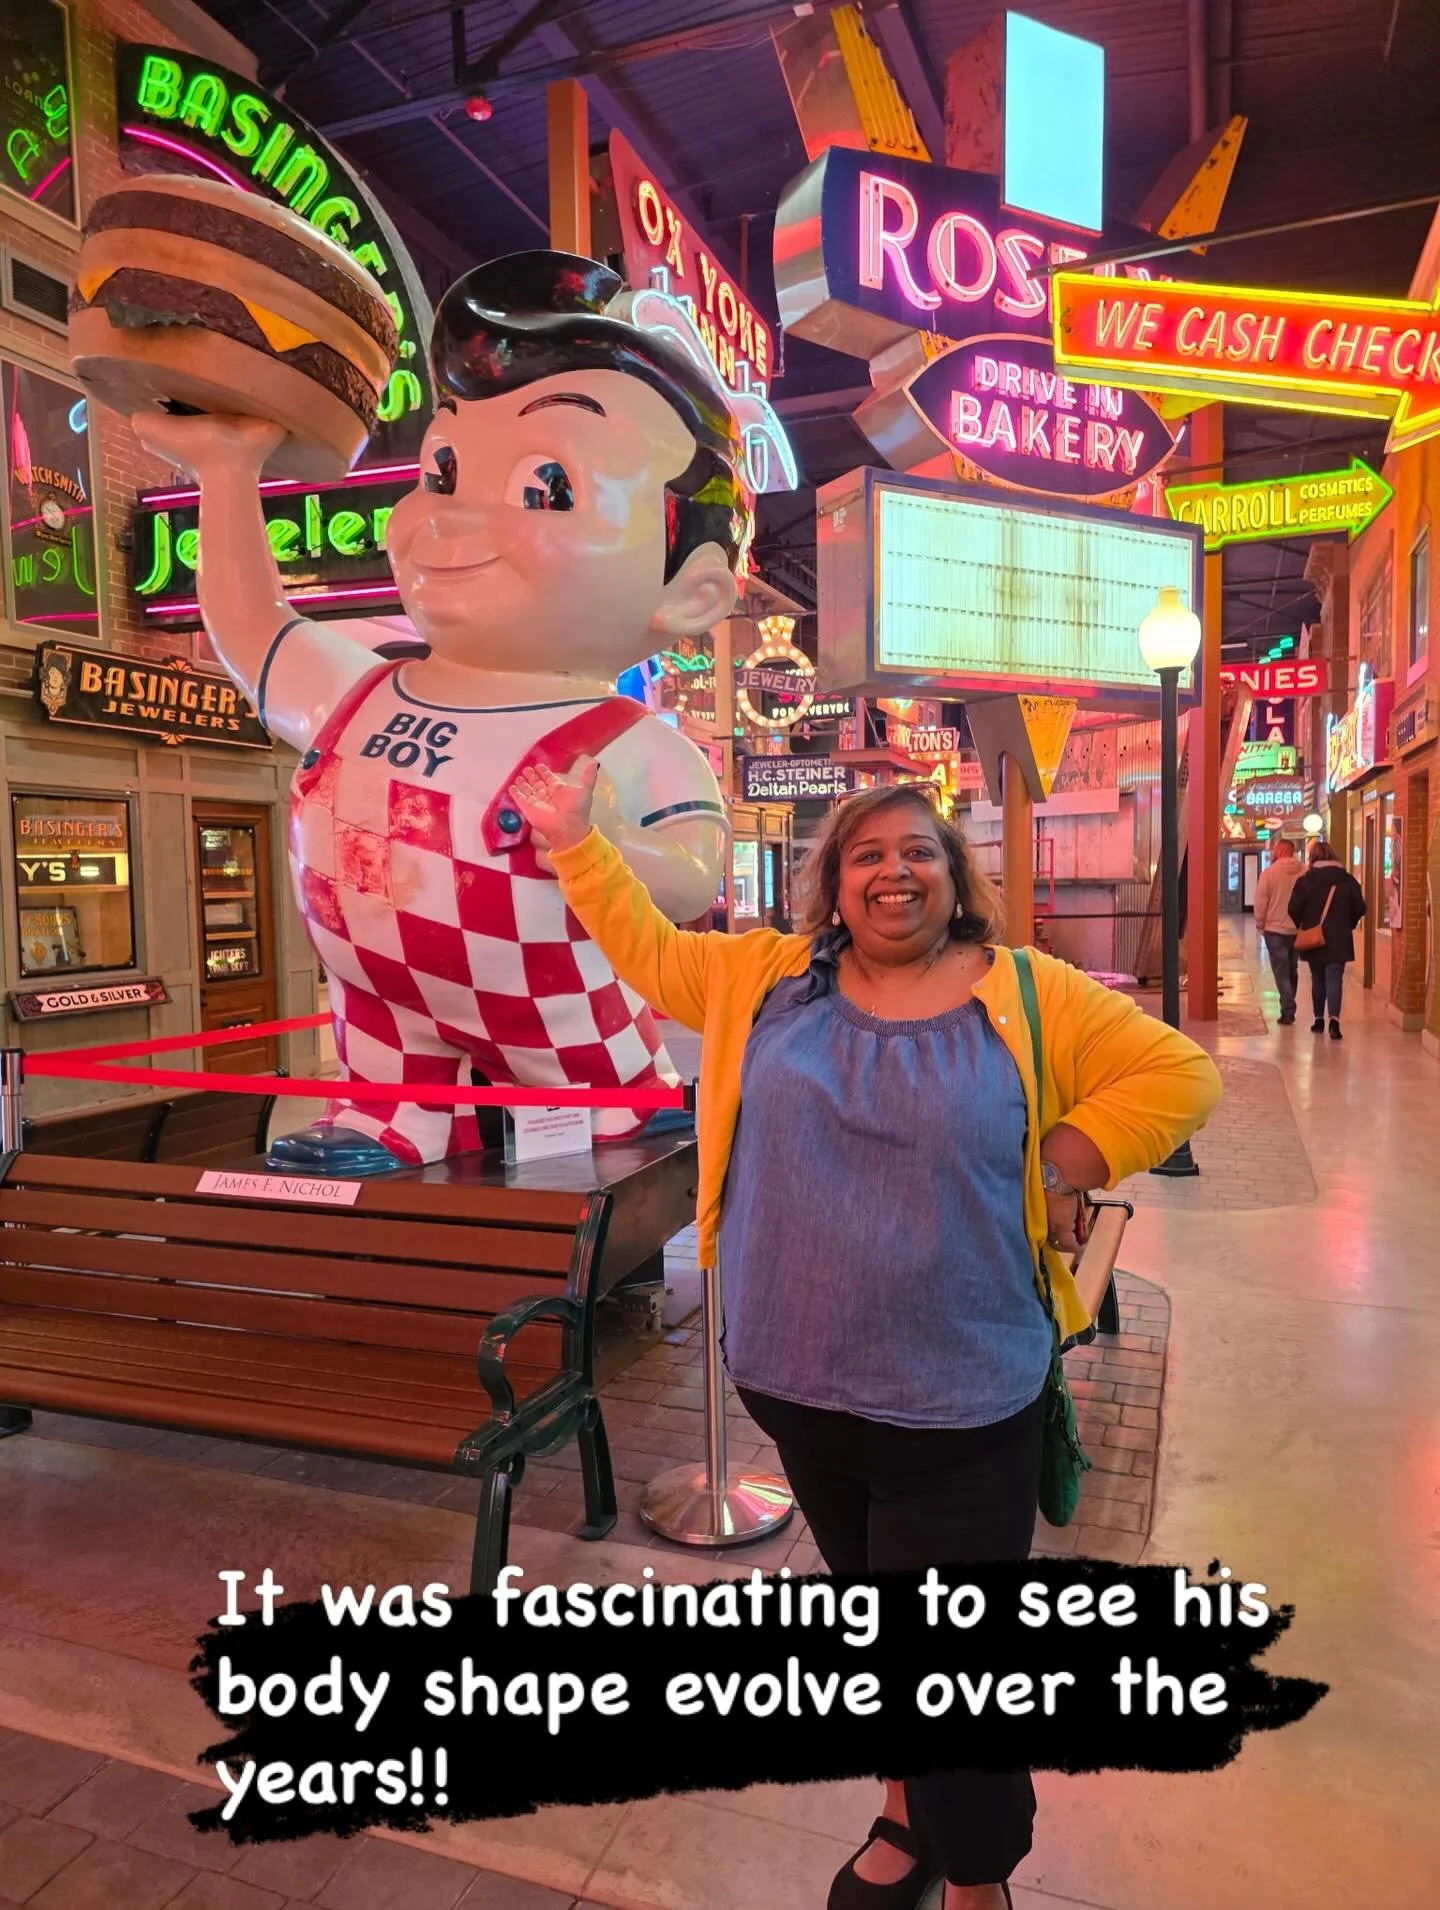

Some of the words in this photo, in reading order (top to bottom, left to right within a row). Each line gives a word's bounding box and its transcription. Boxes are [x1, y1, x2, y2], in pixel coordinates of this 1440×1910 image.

[137, 54, 423, 422] BASING'S
[700, 251, 767, 377] YOKE
[1095, 299, 1164, 351] WE
[1176, 306, 1286, 363] CASH
[974, 355, 1077, 411] DRIVE
[952, 390, 1144, 476] BAKERY
[1299, 476, 1373, 499] COSMETICS
[1299, 501, 1372, 525] PERFUMES
[736, 670, 817, 694] JEWELRY
[102, 701, 241, 731] JEWELERS
[383, 713, 458, 748] BIG
[360, 734, 455, 778] BOY
[747, 783, 798, 798] Deltah
[799, 780, 848, 796] Pearls
[1246, 791, 1302, 806] BARBER
[20, 819, 123, 837] BASINGER'S
[19, 861, 67, 882] Y'S
[47, 994, 88, 1009] GOLD
[100, 988, 142, 1002] SILVER
[214, 1173, 260, 1191] JAMES
[279, 1180, 341, 1198] NICHOL
